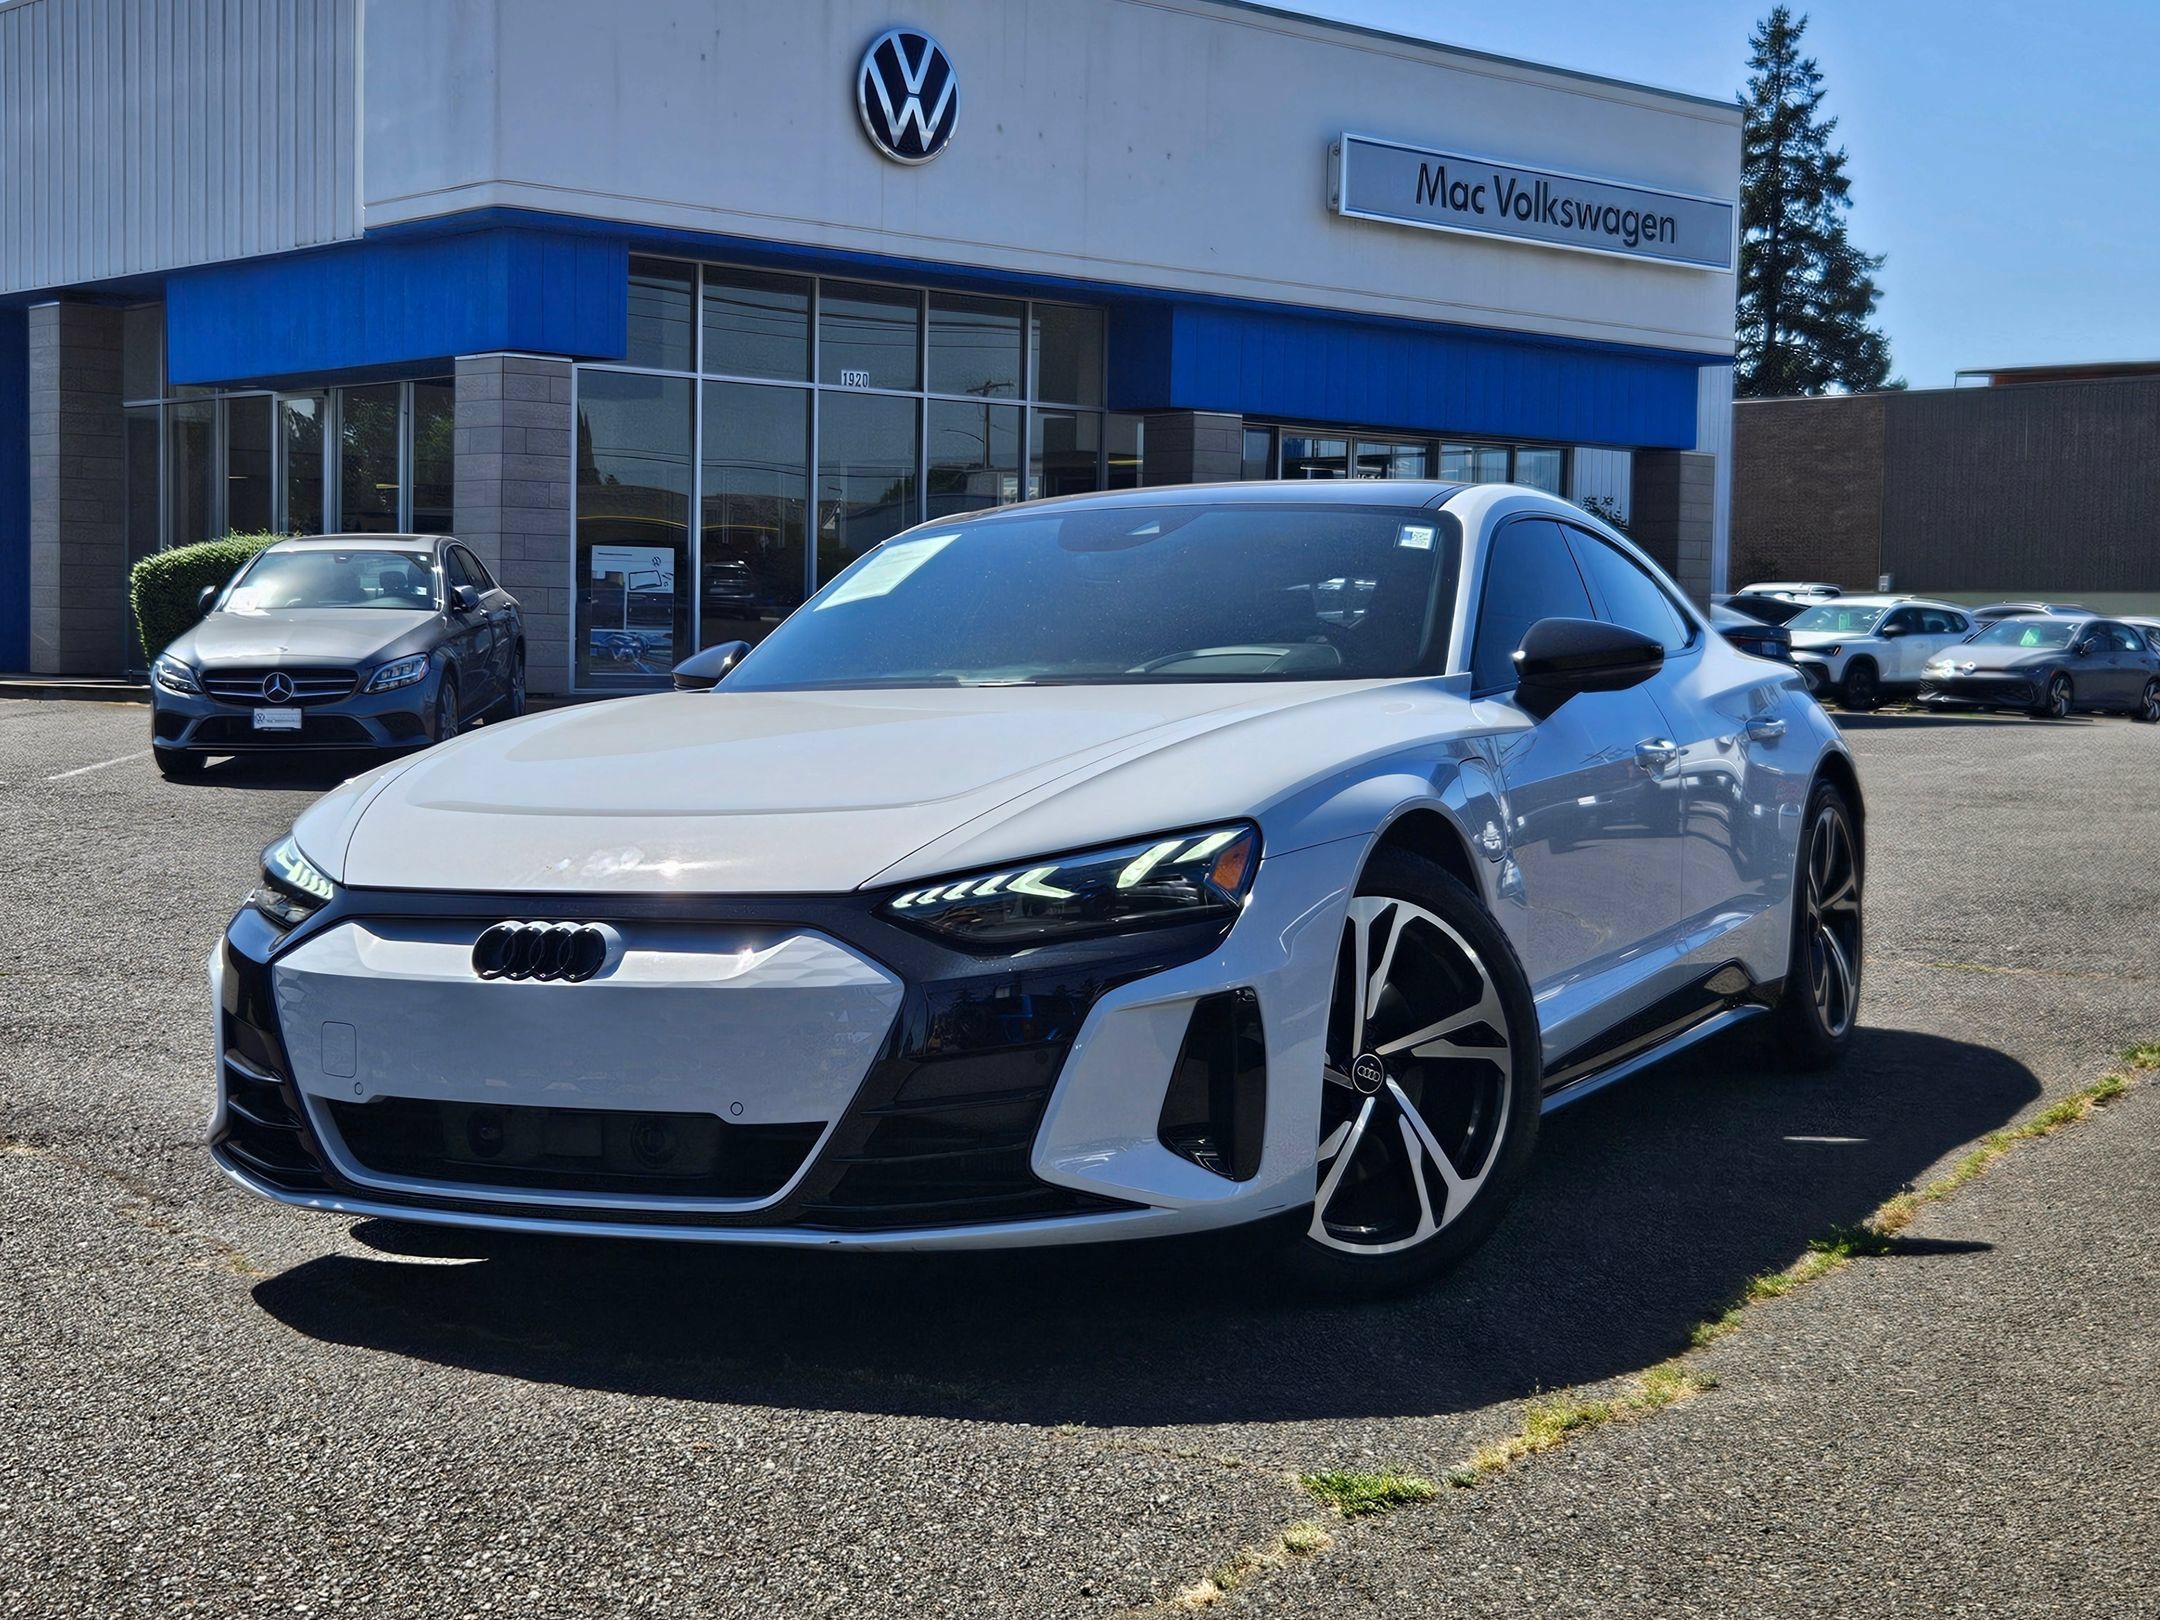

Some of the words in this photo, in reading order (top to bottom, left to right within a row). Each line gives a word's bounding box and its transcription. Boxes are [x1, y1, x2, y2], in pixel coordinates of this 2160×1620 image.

[861, 30, 957, 156] VW
[1416, 162, 1485, 215] Mac
[1493, 174, 1676, 248] Volkswagen
[843, 372, 869, 388] 1920
